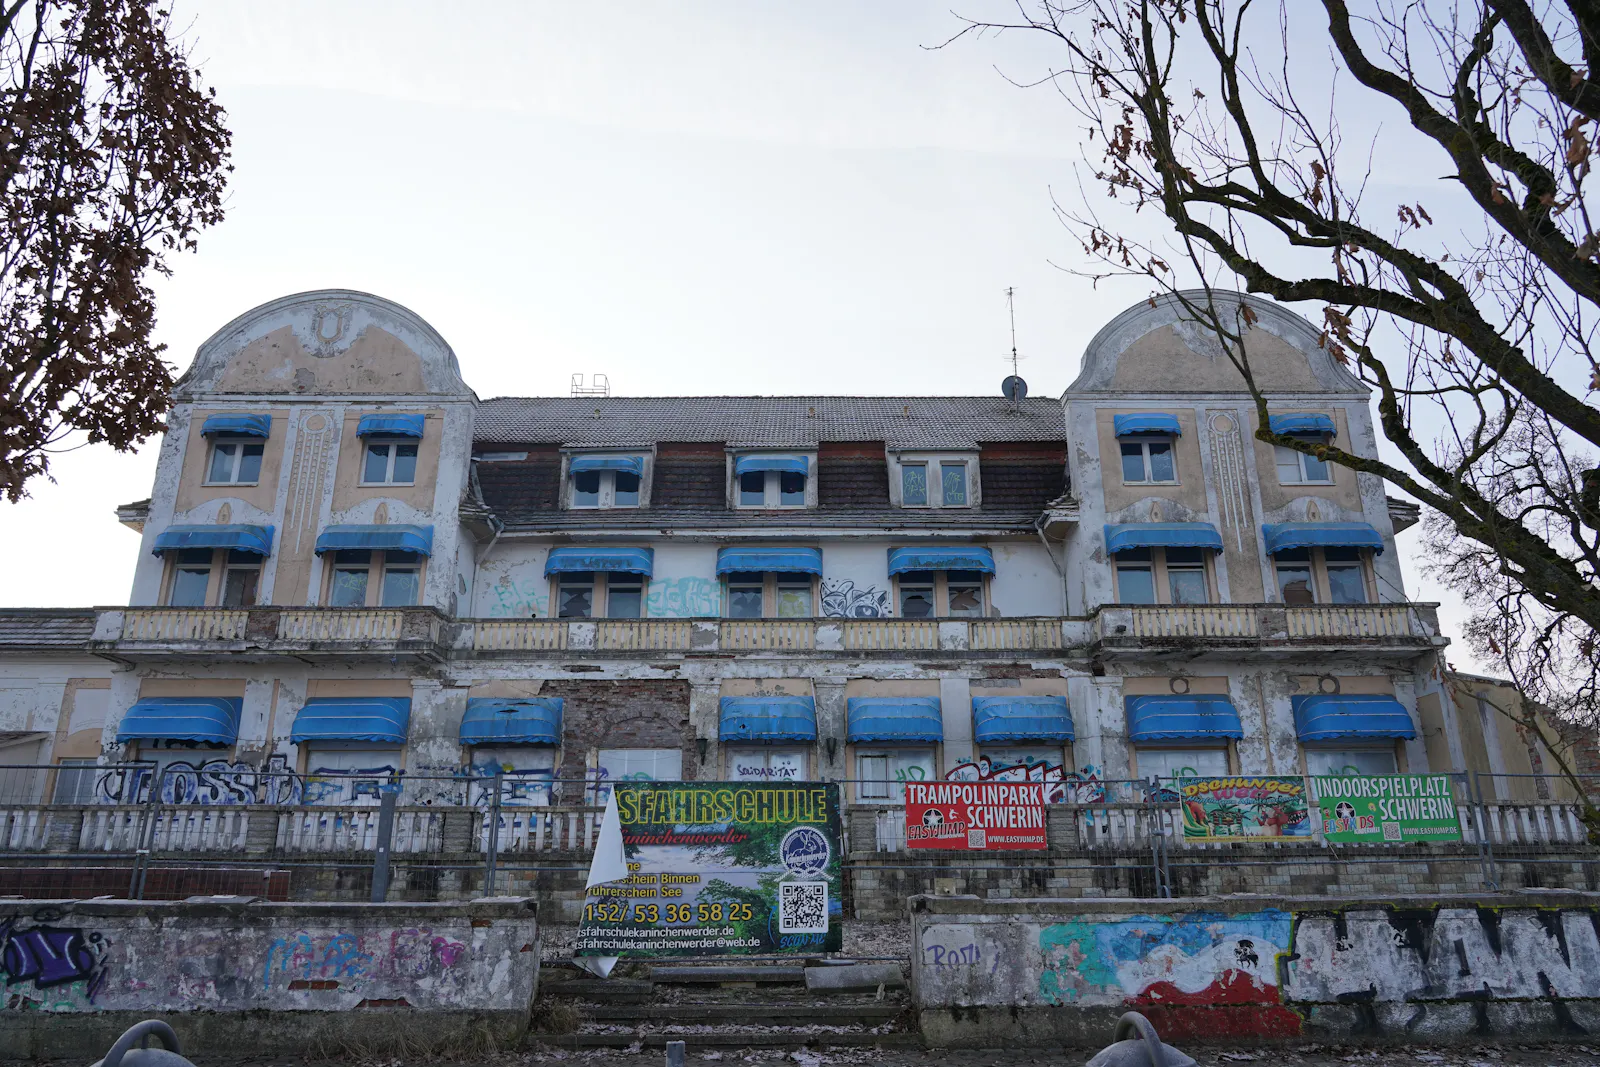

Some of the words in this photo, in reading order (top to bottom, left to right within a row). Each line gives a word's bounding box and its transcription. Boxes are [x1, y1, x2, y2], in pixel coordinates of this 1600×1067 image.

[907, 783, 1041, 805] TRAMPOLINPARK
[1317, 776, 1450, 798] INDOORSPIELPLATZ
[614, 789, 827, 824] SFAHRSCHULE
[1378, 797, 1455, 821] SCHWERIN
[966, 805, 1043, 829] SCHWERIN
[1322, 814, 1375, 834] EASYKIDS
[621, 828, 748, 845] aninchenwerder
[987, 834, 1044, 844] WWW.EASYJUMP.DE
[1402, 826, 1458, 836] WWW.EASYJUMP.DE
[660, 873, 700, 884] Binnen
[660, 886, 682, 897] See
[634, 904, 660, 923] 53
[665, 904, 692, 922] 36
[698, 903, 722, 922] 58
[729, 903, 753, 921] 25
